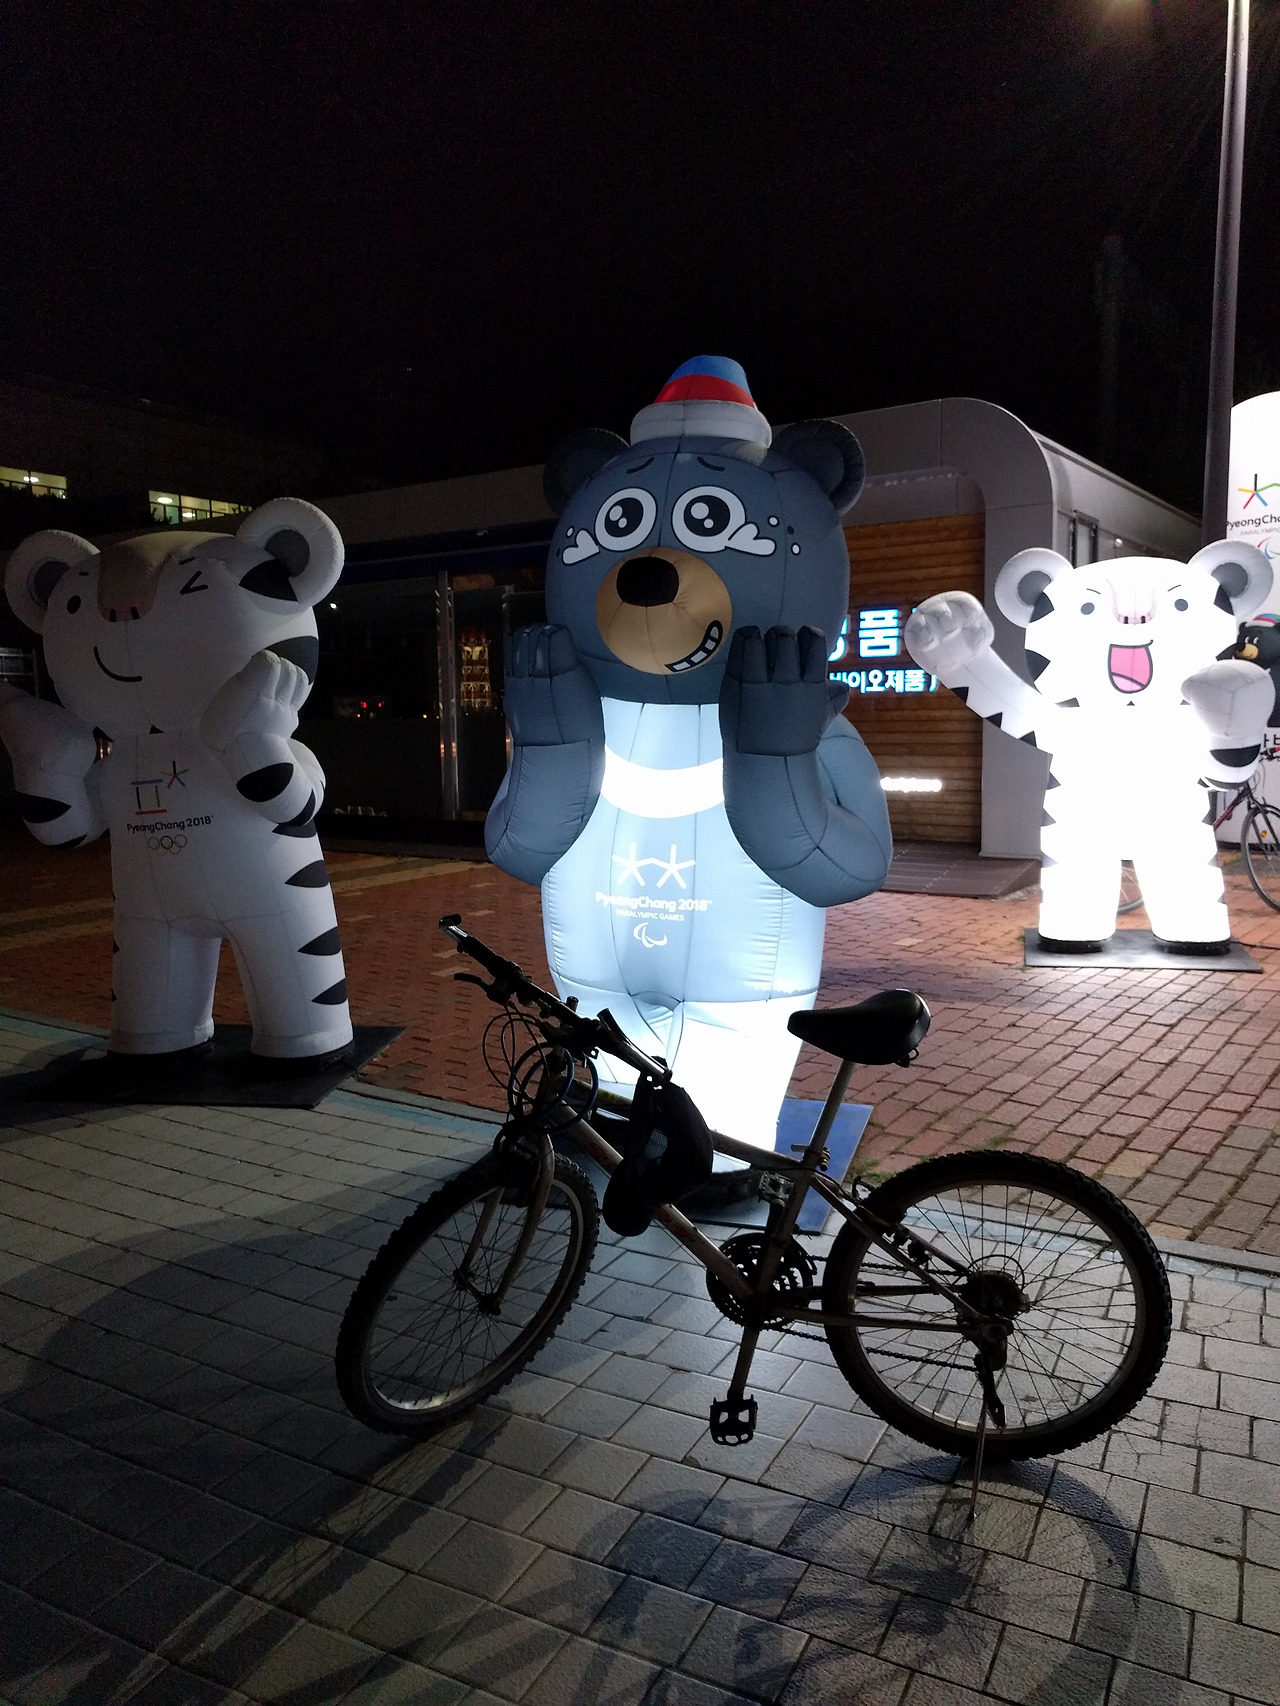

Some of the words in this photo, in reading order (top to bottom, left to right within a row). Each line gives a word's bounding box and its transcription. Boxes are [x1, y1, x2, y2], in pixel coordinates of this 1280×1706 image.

[127, 820, 186, 834] PyeongChang
[595, 890, 677, 912] PyeongChang
[616, 908, 659, 920] PARALYMPIC
[659, 912, 685, 921] GAMES
